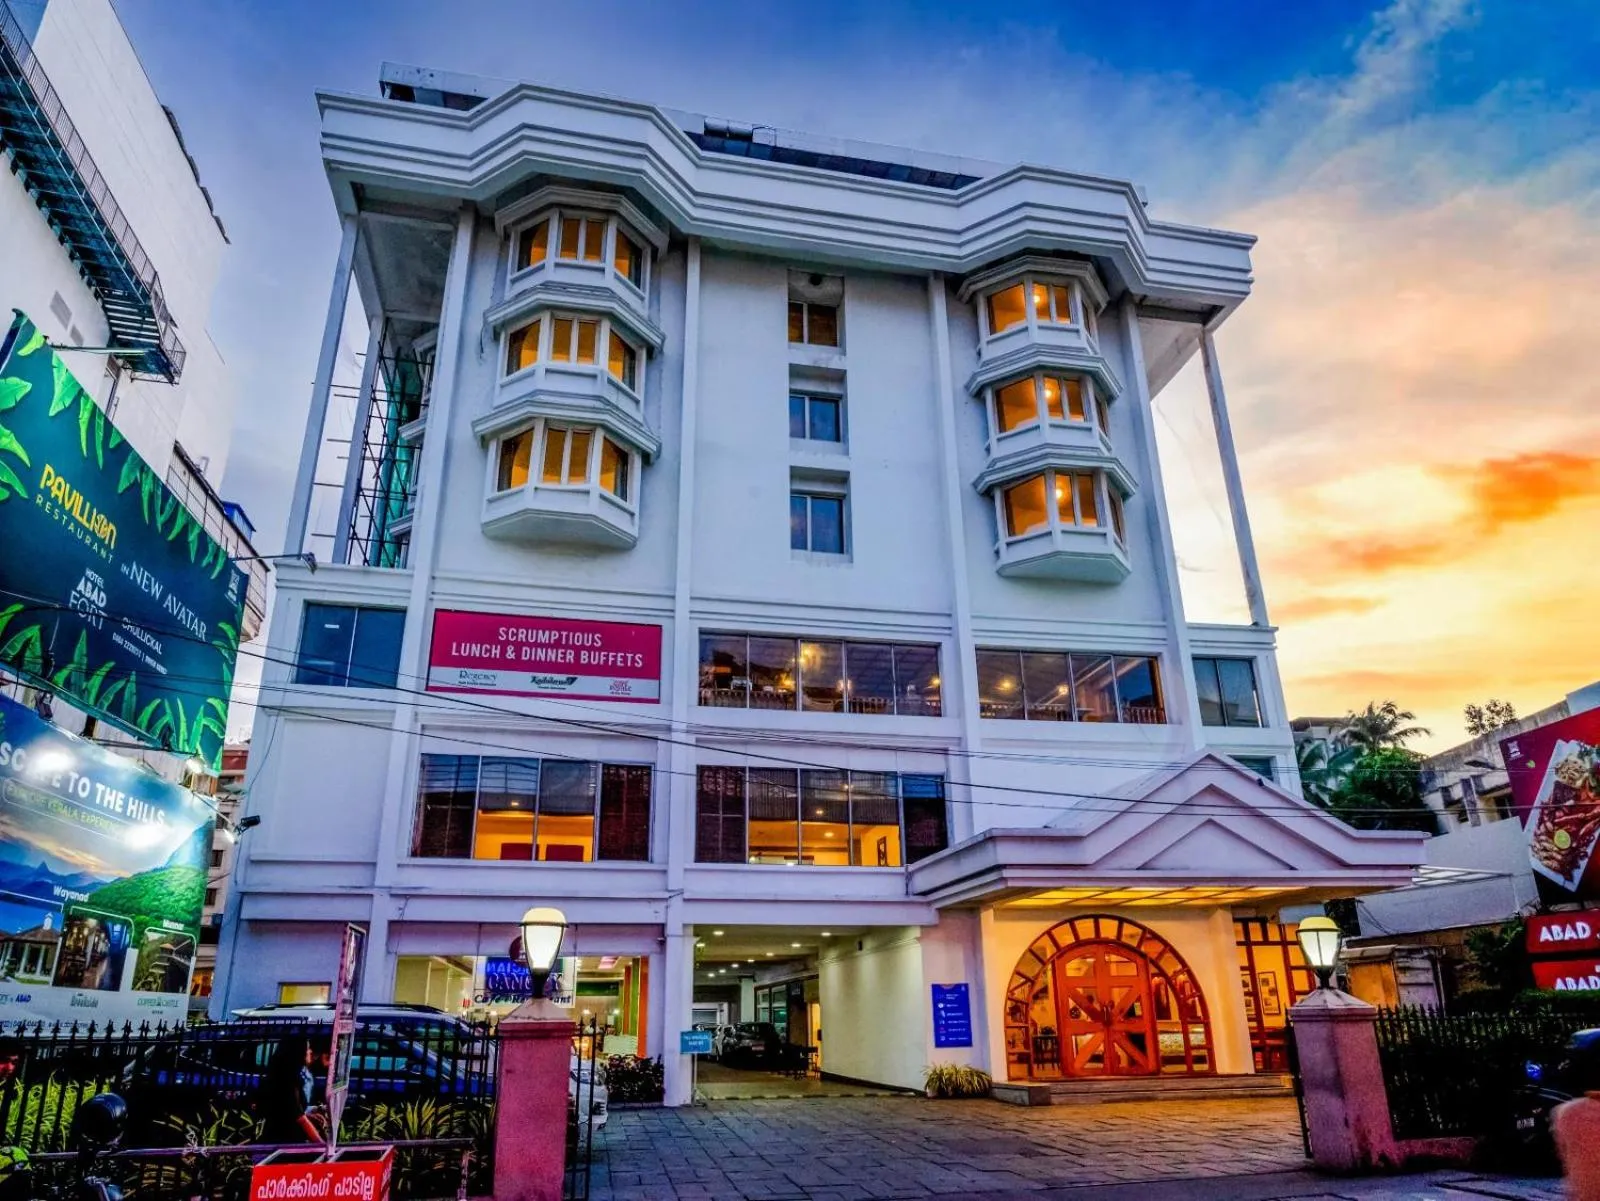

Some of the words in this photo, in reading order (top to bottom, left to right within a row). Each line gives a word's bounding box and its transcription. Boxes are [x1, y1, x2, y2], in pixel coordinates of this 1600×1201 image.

[35, 494, 113, 564] RESTAURANT
[76, 575, 107, 608] ABAD
[85, 567, 105, 589] HOTEL
[69, 590, 108, 630] FORT
[130, 560, 163, 601] NEW
[163, 593, 207, 642] AVATAR
[498, 627, 602, 647] SCRUMPTIOUS
[451, 642, 500, 659] LUNCH
[506, 645, 516, 659] &
[521, 646, 574, 664] DINNER
[580, 651, 643, 668] BUFFETS
[68, 770, 90, 798] TO
[95, 782, 125, 813] THE
[126, 796, 165, 826] HILLS
[53, 885, 89, 902] Wayanad
[1540, 921, 1591, 942] ABAD
[1555, 975, 1600, 990] ABAD
[257, 1172, 333, 1198] പാർക്കിംഗ്
[334, 1170, 375, 1200] പാടില്ല
